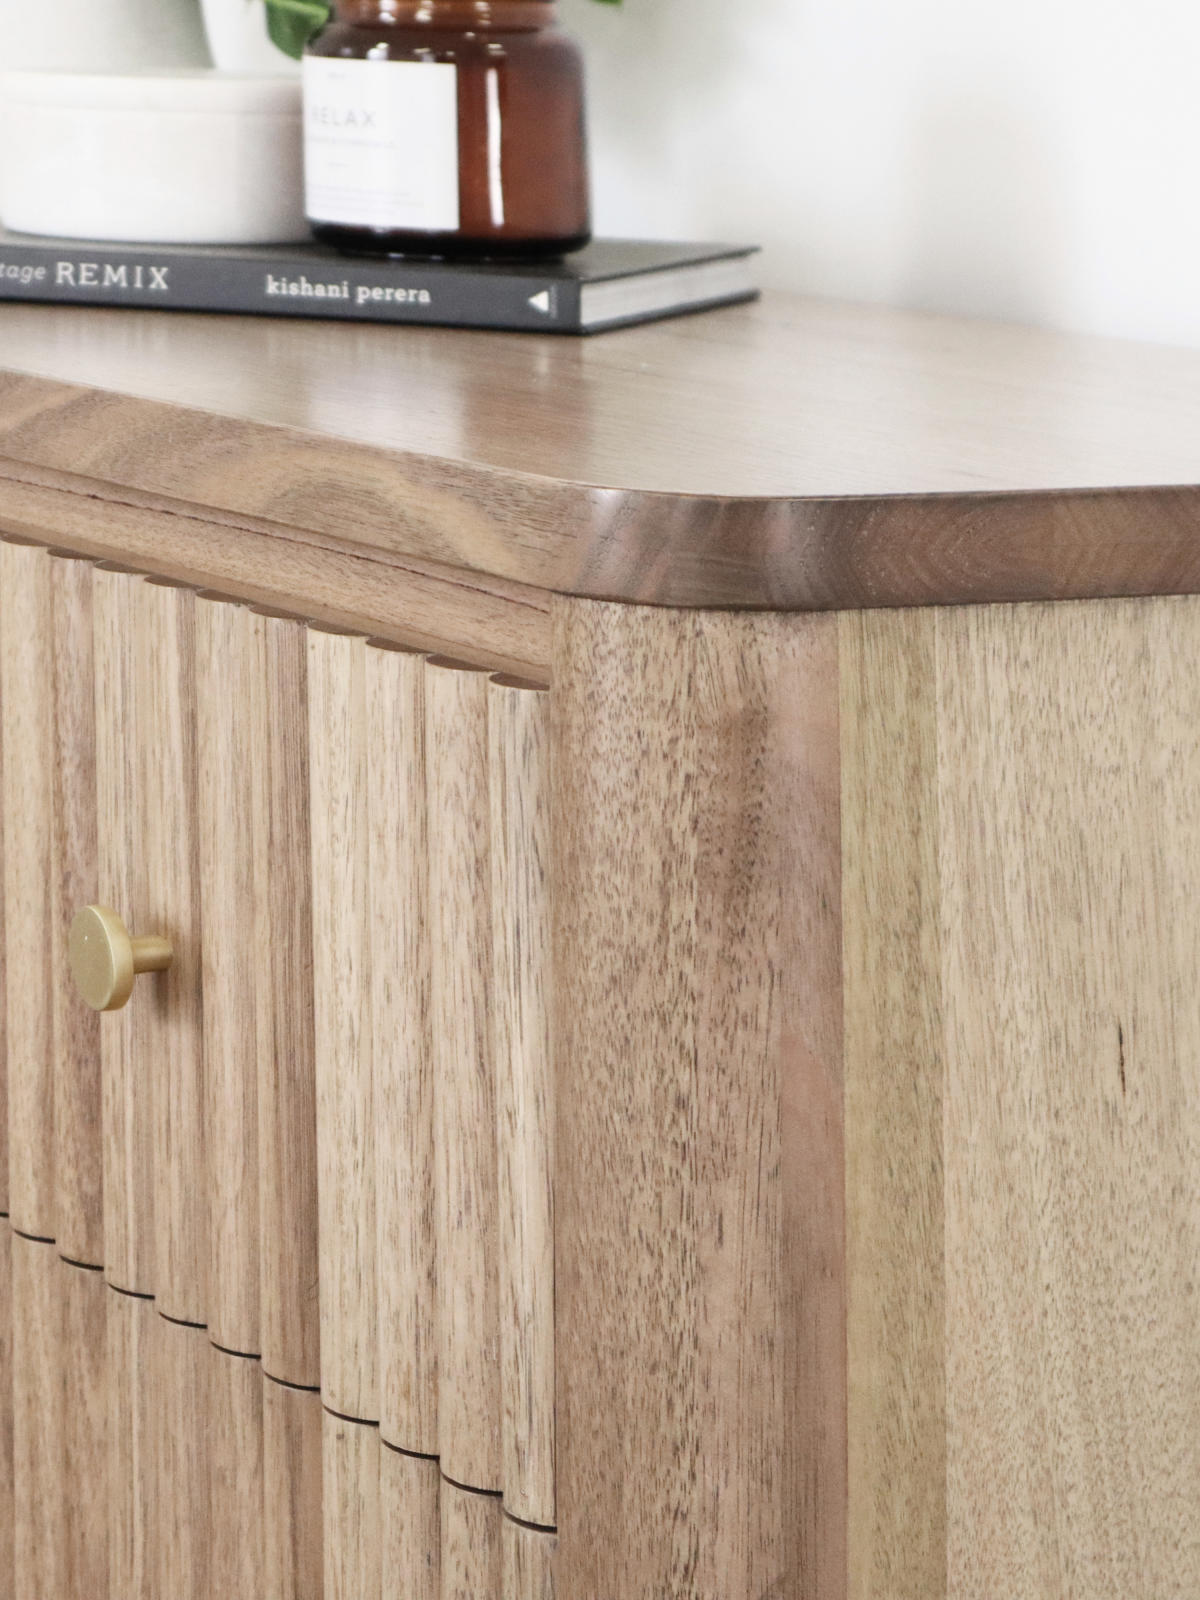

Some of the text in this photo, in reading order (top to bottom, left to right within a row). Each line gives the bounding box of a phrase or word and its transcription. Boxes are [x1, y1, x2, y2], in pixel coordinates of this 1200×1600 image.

[55, 261, 169, 290] REMIX
[265, 275, 431, 303] kishani perera
